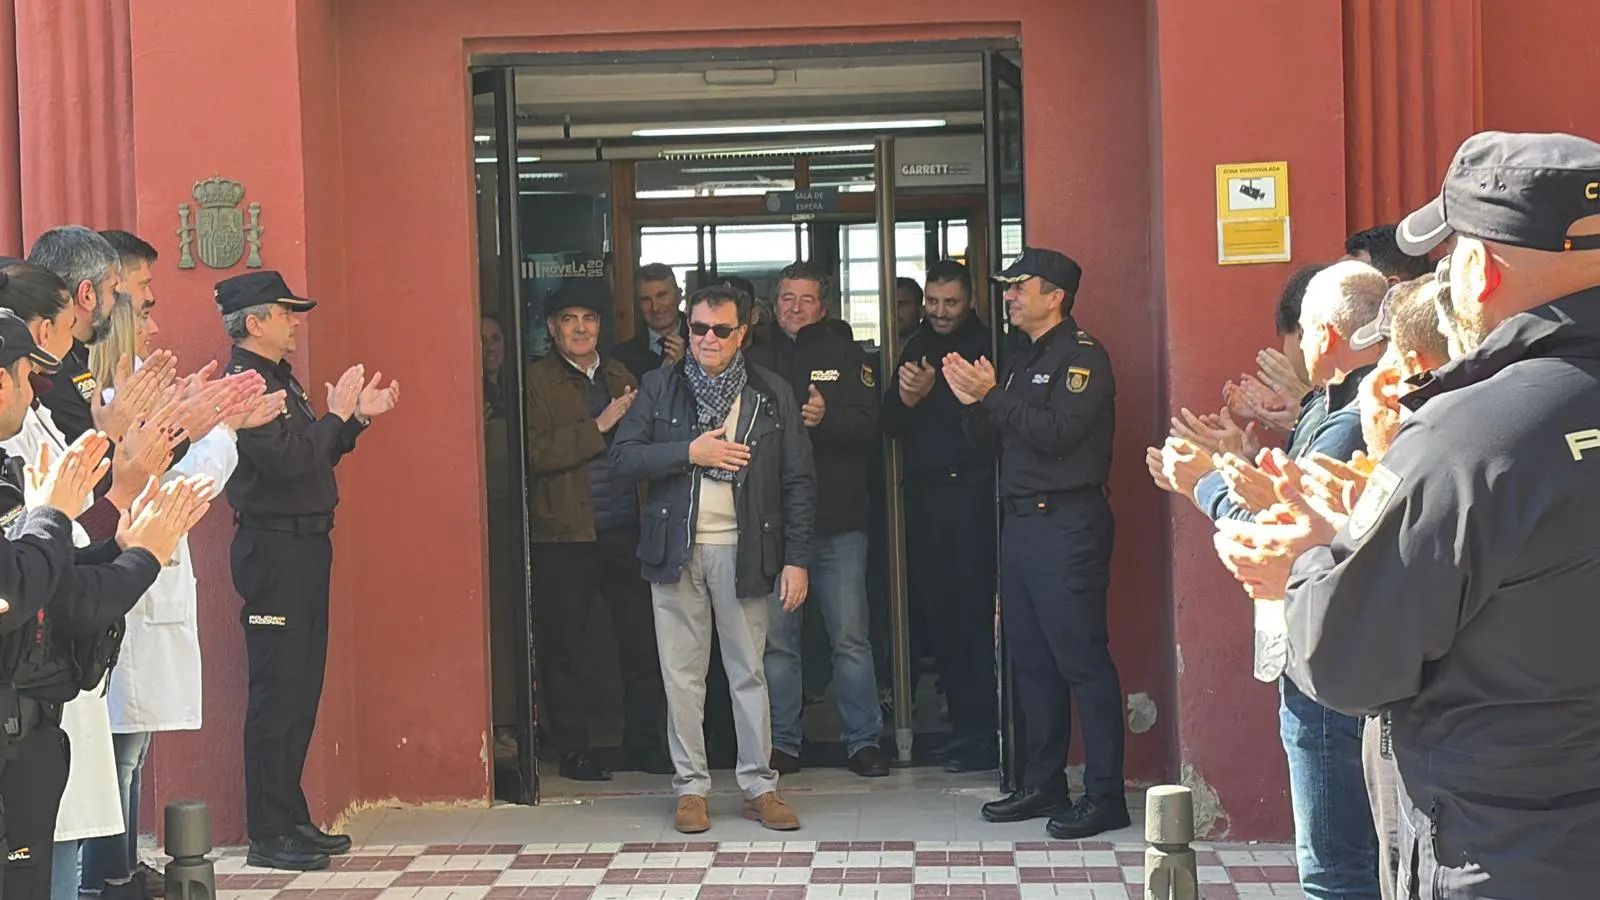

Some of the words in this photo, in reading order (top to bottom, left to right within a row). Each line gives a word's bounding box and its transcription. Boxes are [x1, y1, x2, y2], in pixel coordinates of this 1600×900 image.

[902, 164, 948, 175] GARRETT
[794, 192, 813, 200] SALA
[814, 192, 823, 200] DE
